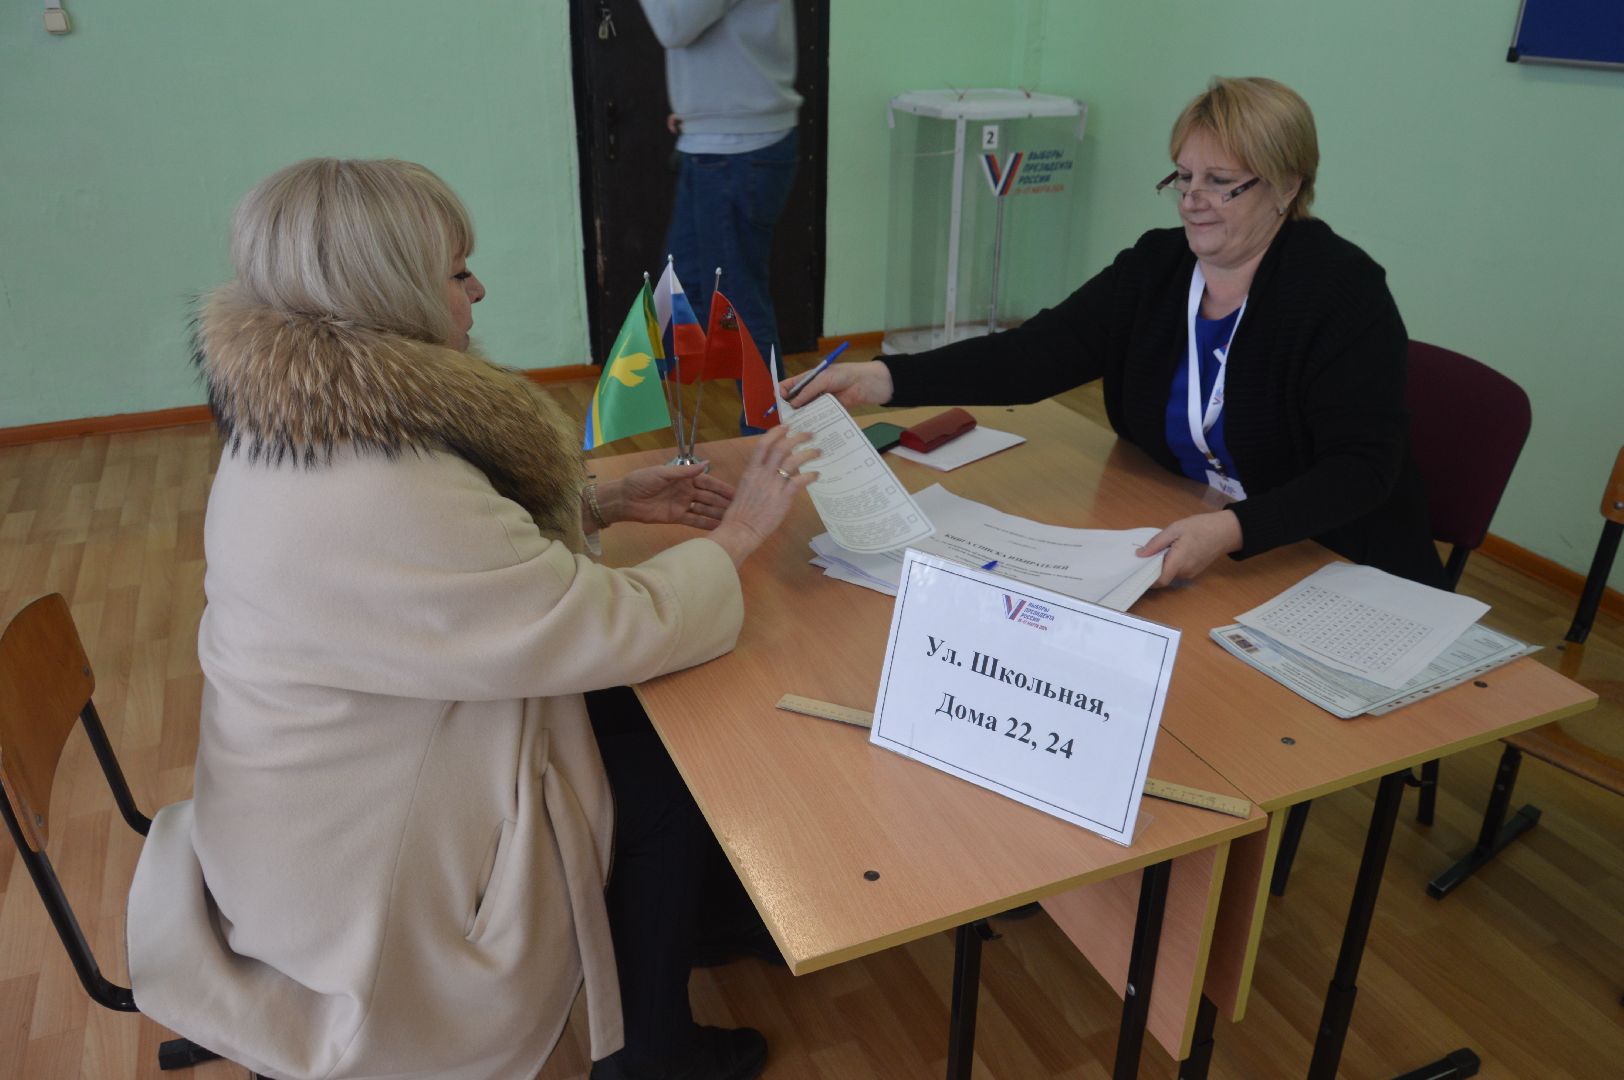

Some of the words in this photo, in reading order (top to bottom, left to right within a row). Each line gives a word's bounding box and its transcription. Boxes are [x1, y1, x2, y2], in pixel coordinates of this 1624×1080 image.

[986, 131, 994, 144] 2
[926, 635, 962, 667] Ул.
[970, 650, 1111, 722] Школьная,
[935, 692, 997, 732] Дома
[1004, 717, 1038, 750] 22,
[1045, 732, 1074, 759] 24
